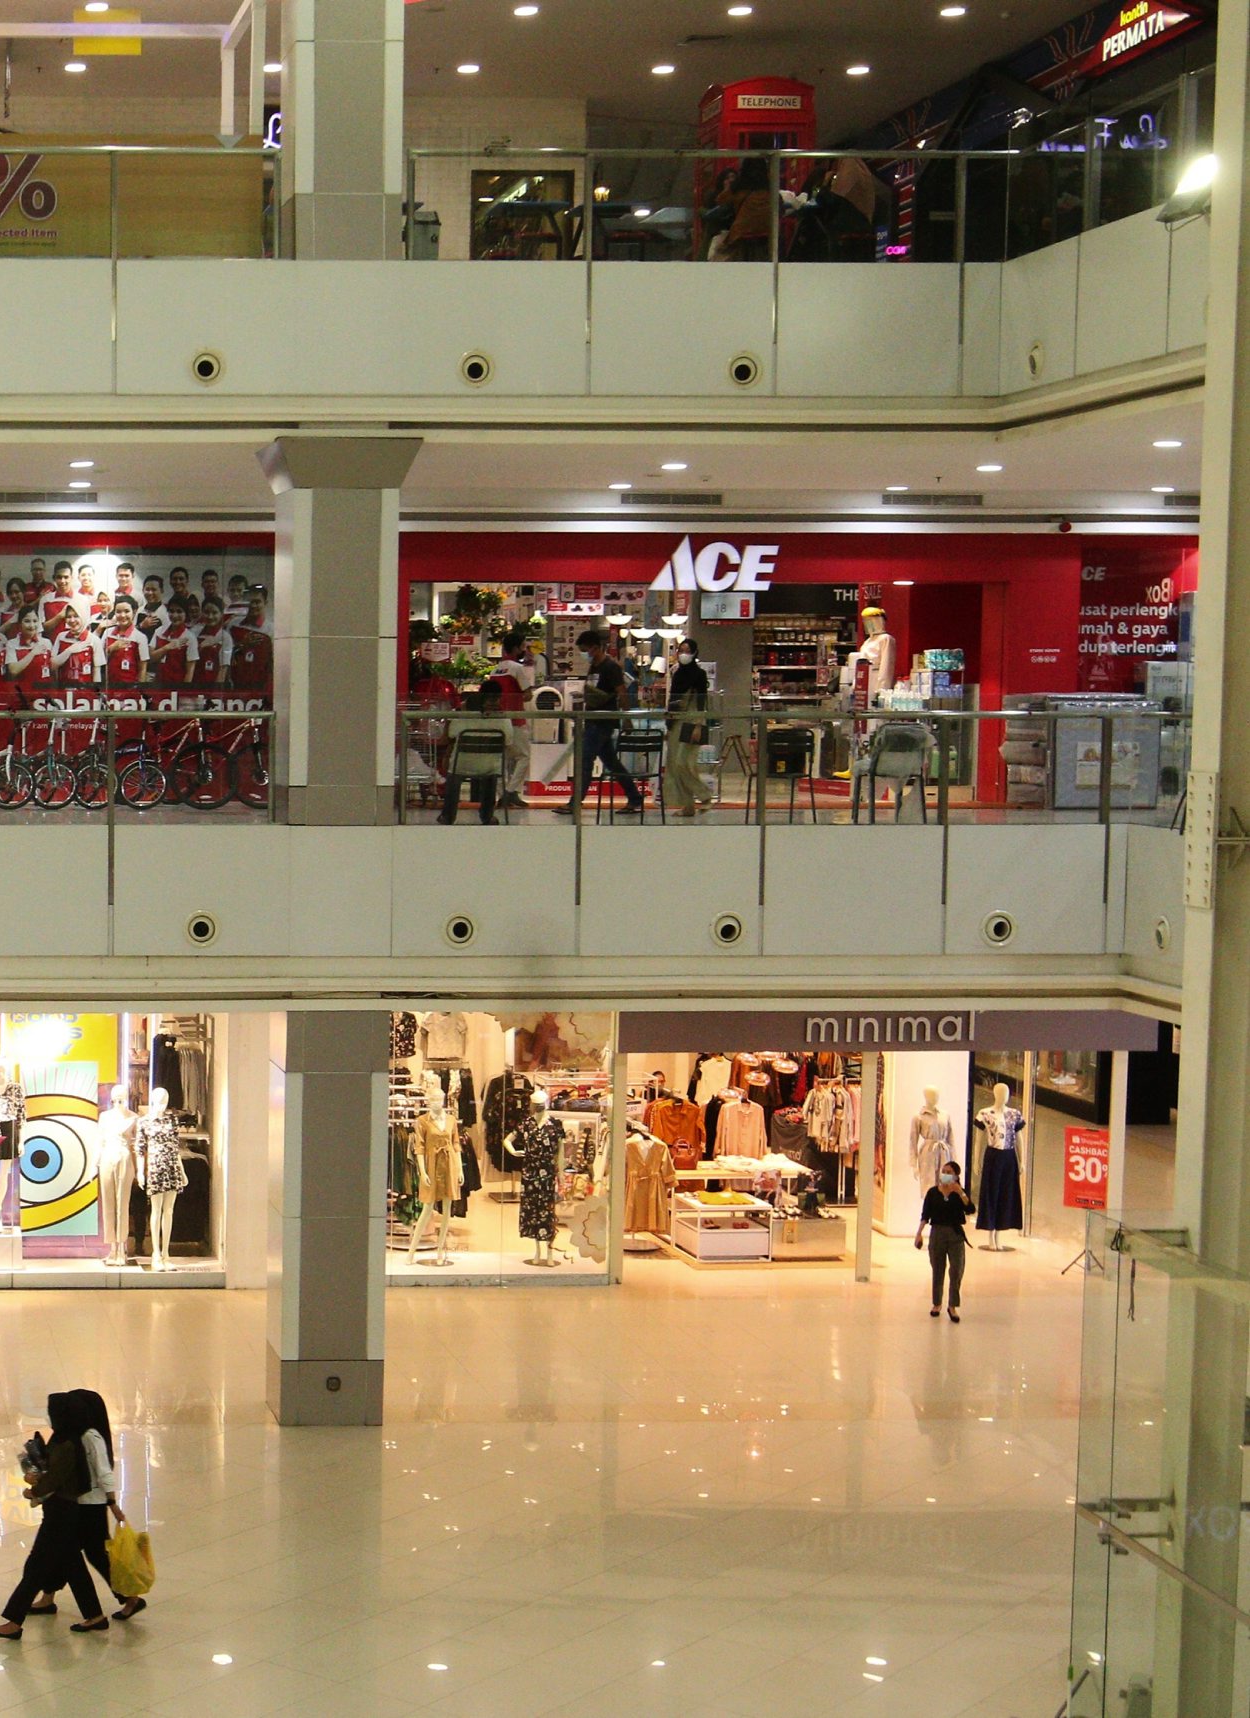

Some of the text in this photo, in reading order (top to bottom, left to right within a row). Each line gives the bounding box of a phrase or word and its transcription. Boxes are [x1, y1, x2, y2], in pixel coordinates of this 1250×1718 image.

[1119, 1, 1148, 26] kantin
[1102, 11, 1165, 61] PERMATA
[742, 97, 798, 107] TELEPHONE
[31, 229, 57, 238] Item
[650, 535, 779, 590] ACE
[1078, 622, 1168, 638] mah & gaya
[158, 691, 263, 711] dtang
[806, 1010, 976, 1043] minimal
